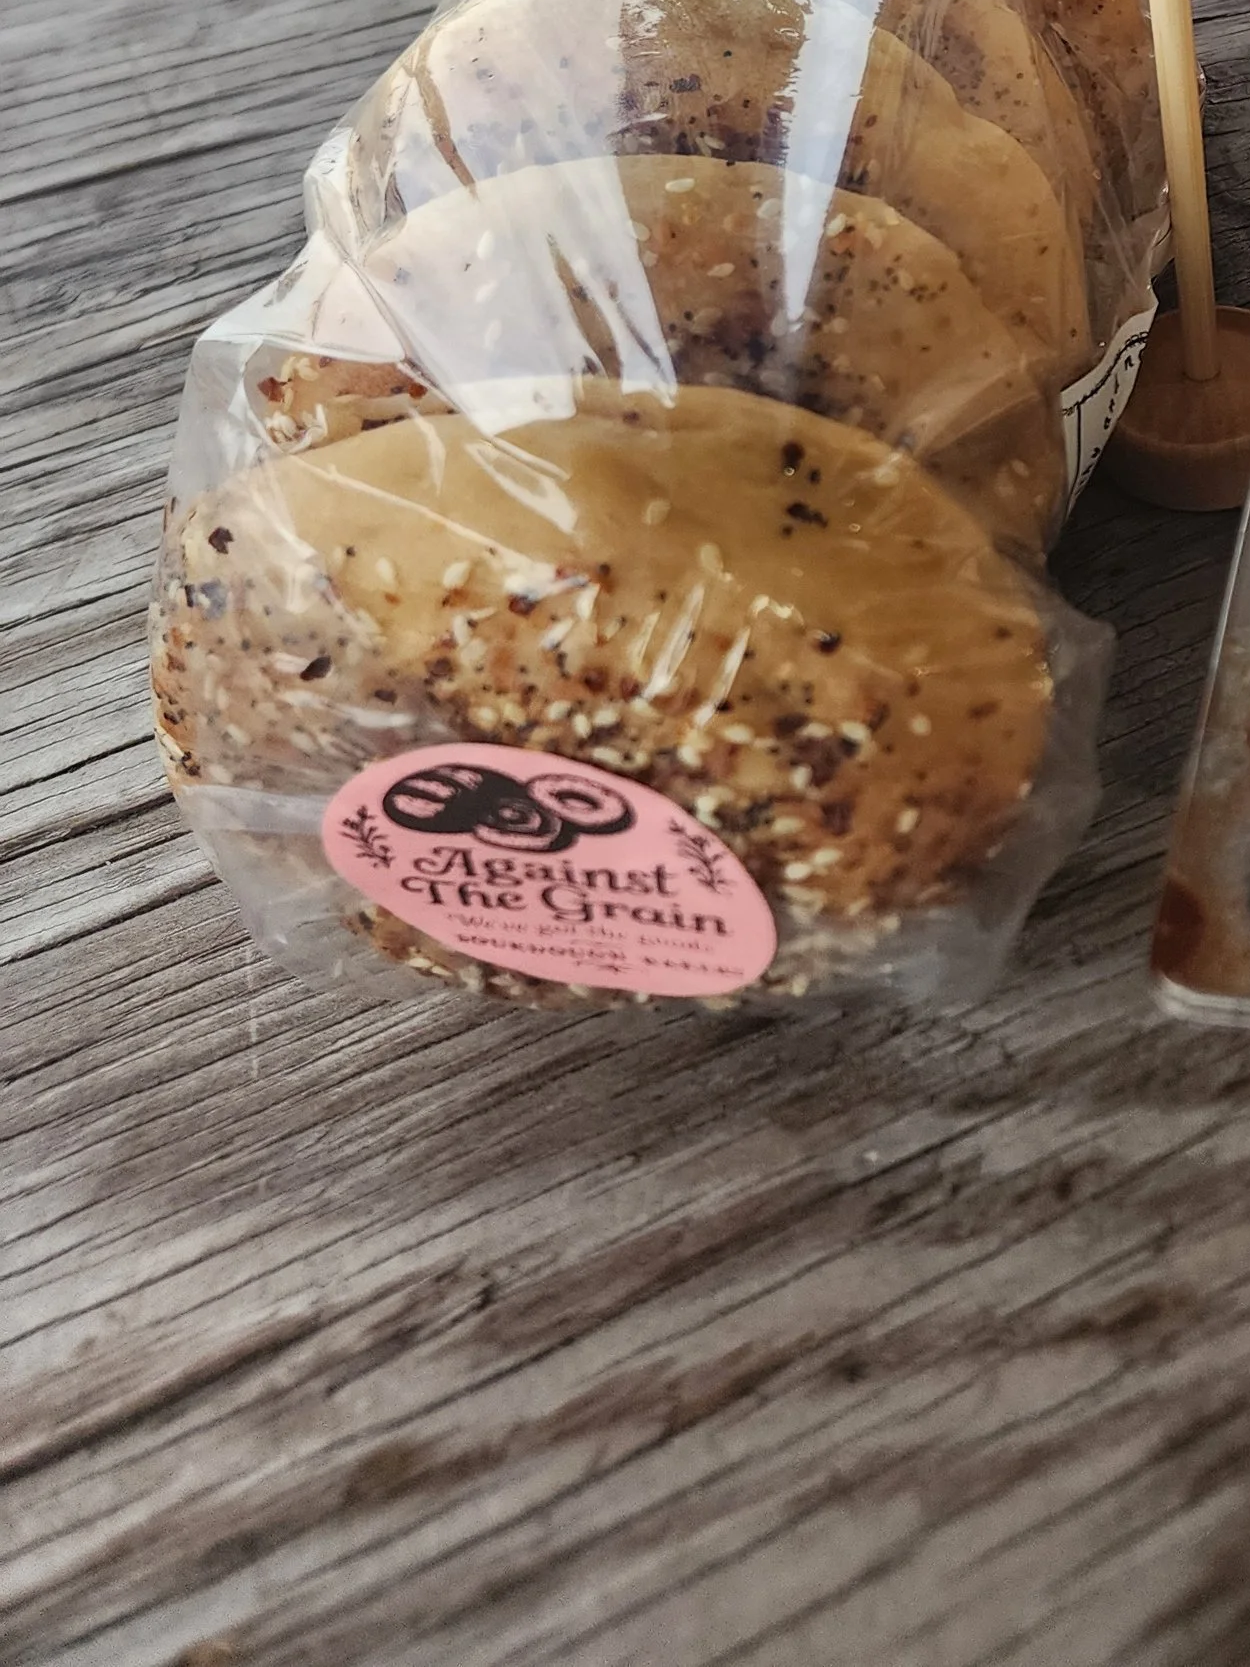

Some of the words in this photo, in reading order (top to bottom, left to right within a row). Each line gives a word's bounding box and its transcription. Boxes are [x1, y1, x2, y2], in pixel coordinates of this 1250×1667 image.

[412, 845, 679, 897] Against
[400, 875, 527, 912] The
[541, 881, 731, 937] Grain
